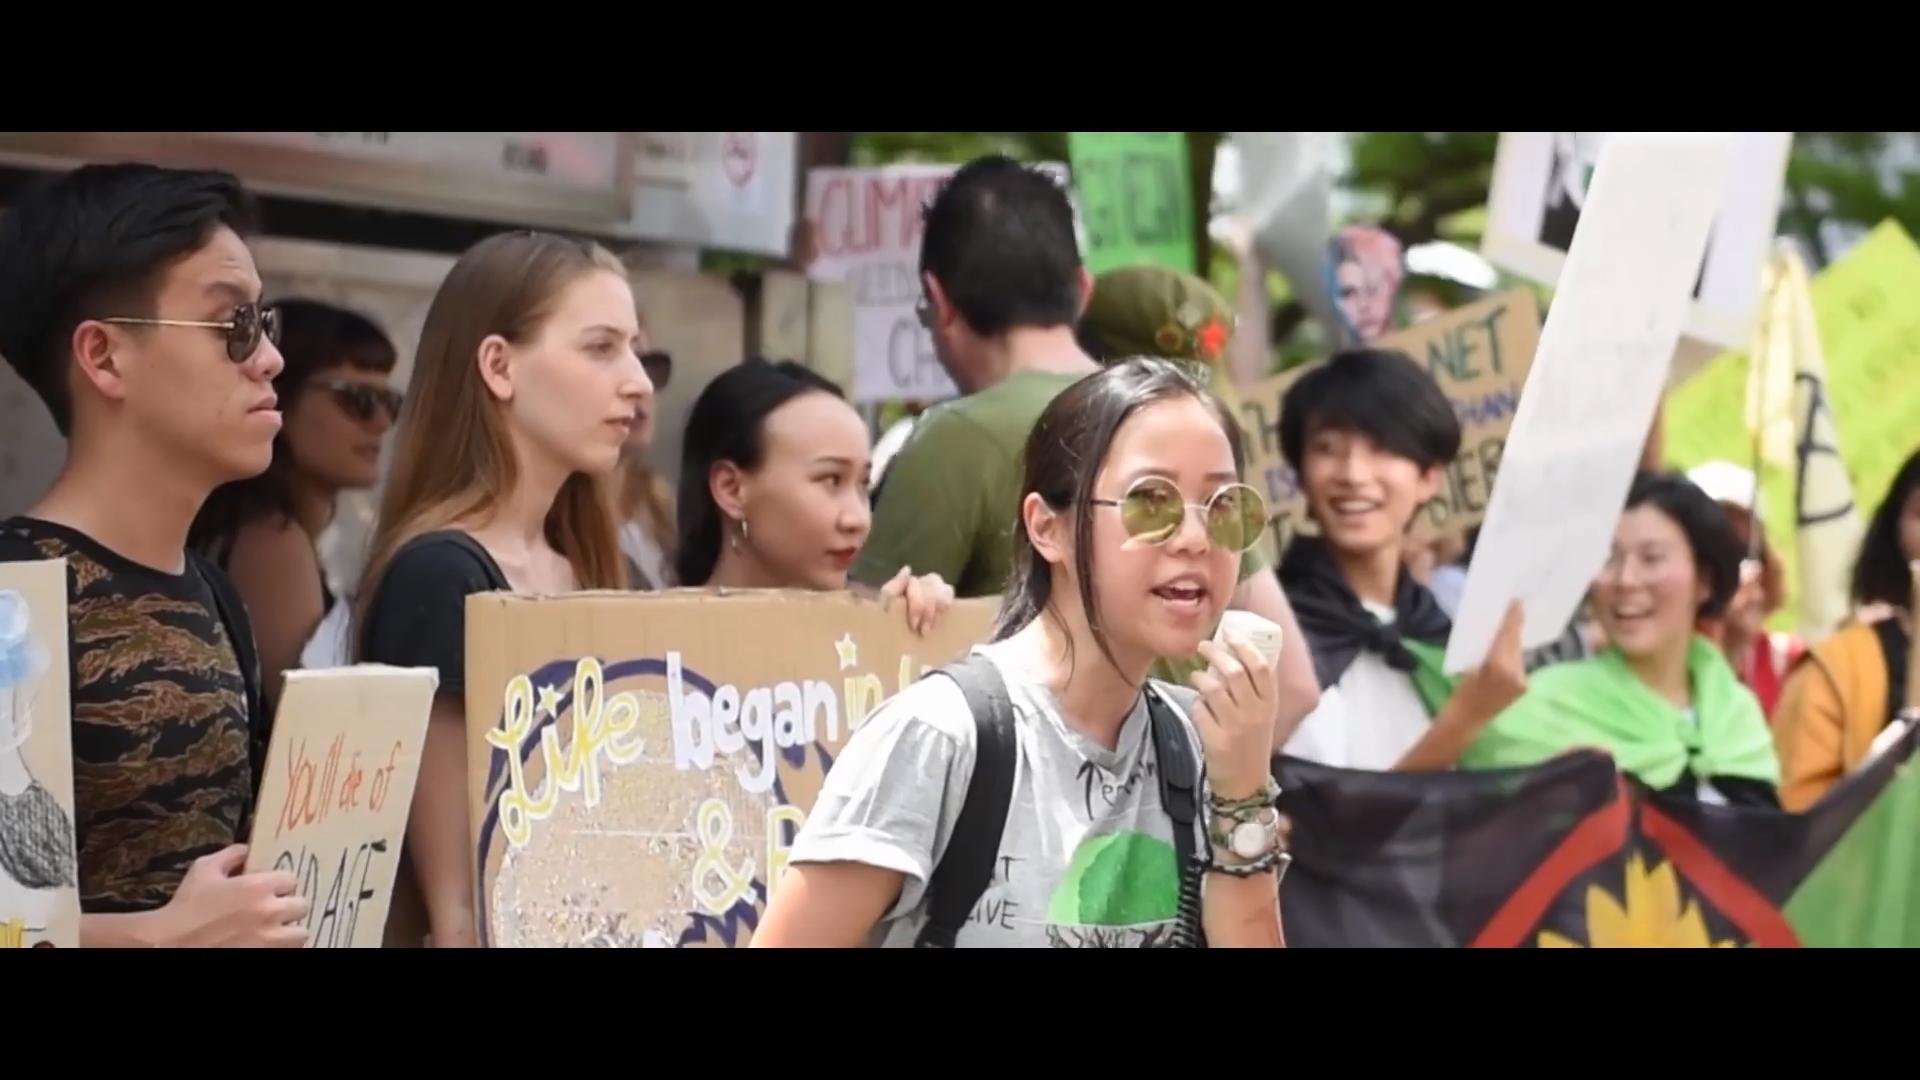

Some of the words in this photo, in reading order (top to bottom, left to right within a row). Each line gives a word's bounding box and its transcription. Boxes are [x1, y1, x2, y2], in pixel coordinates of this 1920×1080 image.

[1427, 305, 1507, 380] NET
[369, 740, 402, 813] of
[486, 655, 645, 847] Life
[666, 651, 838, 793] began
[834, 632, 883, 731] in
[692, 799, 758, 915] &
